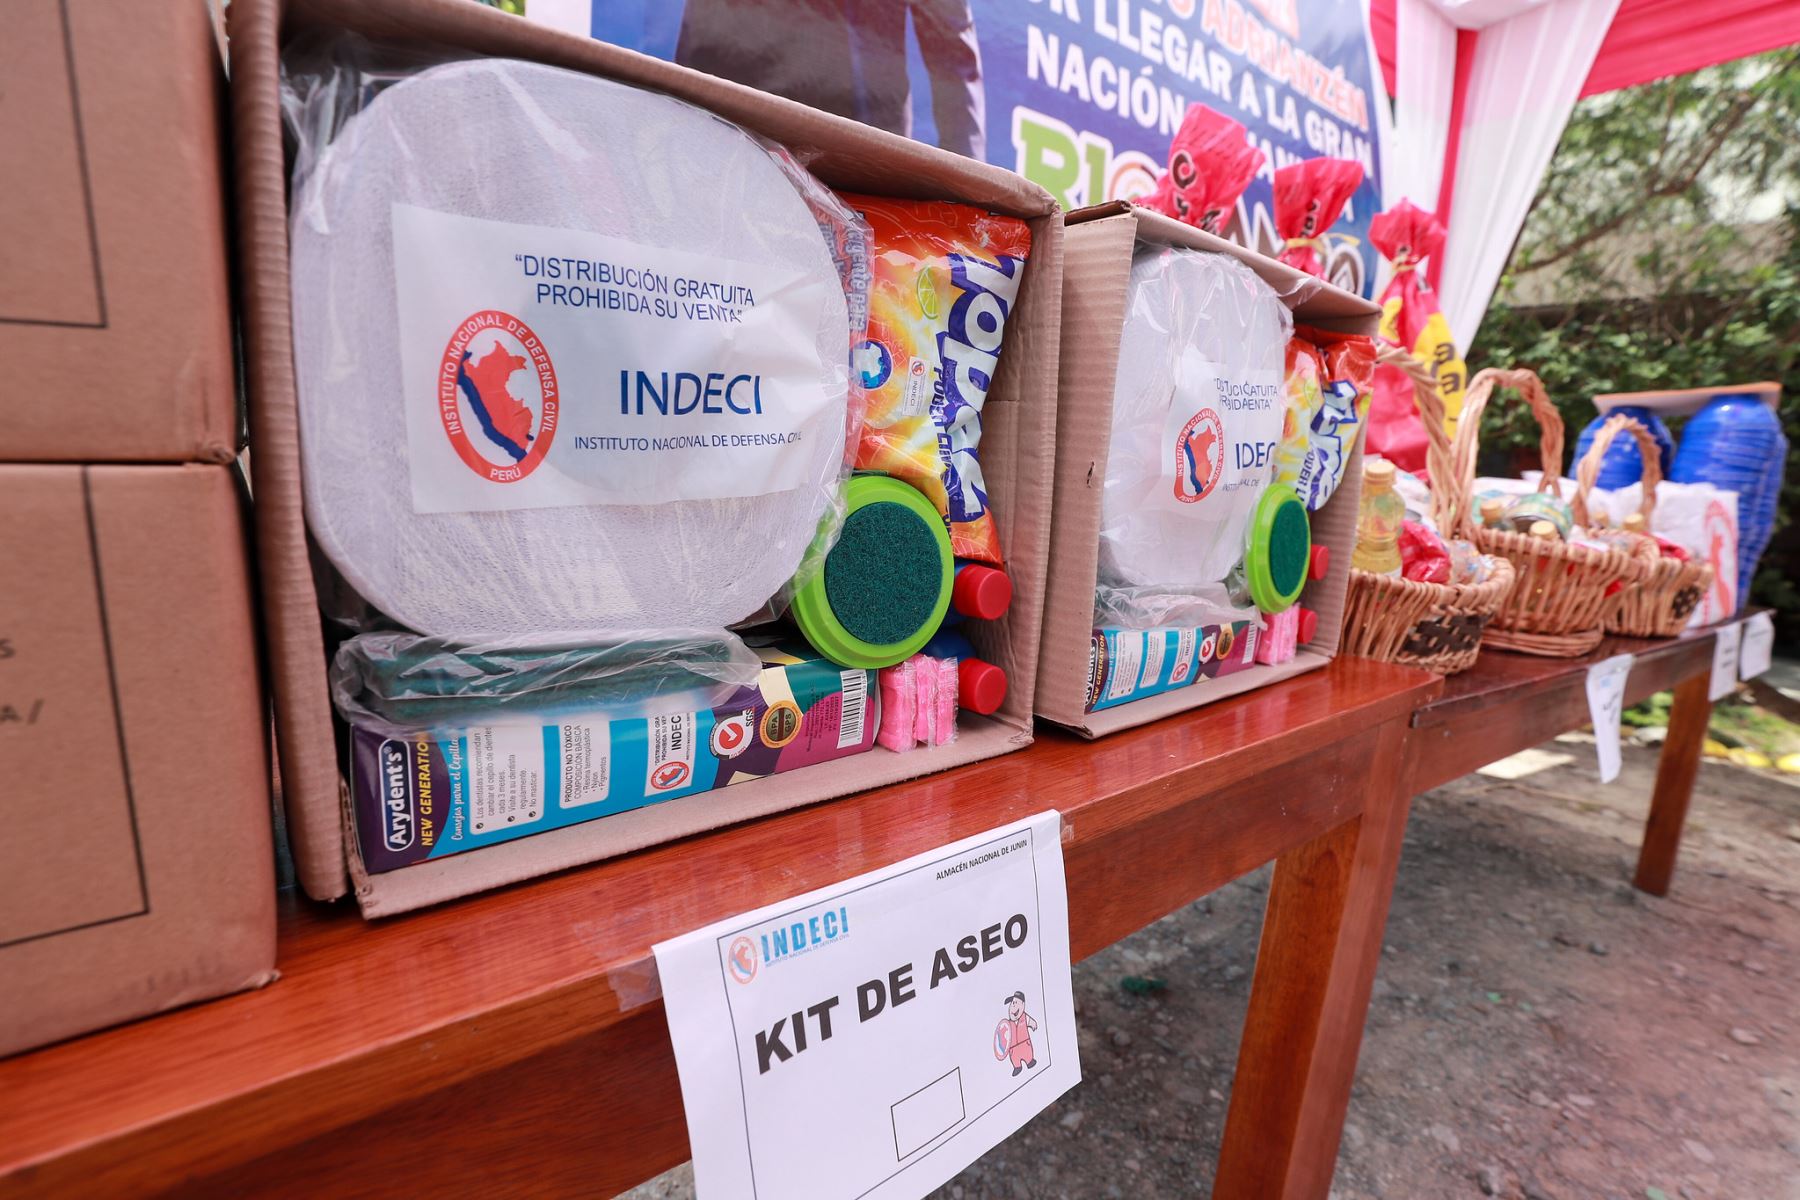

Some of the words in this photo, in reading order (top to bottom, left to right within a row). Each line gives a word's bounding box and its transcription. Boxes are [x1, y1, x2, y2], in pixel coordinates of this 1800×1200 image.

[1027, 24, 1186, 135] NACIÓN
[1094, 0, 1233, 102] LLEGAR
[1239, 71, 1262, 117] A
[1266, 84, 1301, 138] LA
[1304, 110, 1374, 179] GRAN
[537, 283, 651, 316] PROHIBIDA
[654, 299, 678, 319] SU
[673, 278, 755, 307] GRATUITA
[448, 314, 503, 359] NACIONAL
[506, 320, 527, 338] DE
[525, 339, 555, 398] DEFENSA
[441, 362, 462, 436] INSTITUTO
[620, 370, 763, 416] INDECI
[541, 402, 556, 433] CIVIL
[574, 436, 649, 451] INSTITUTO
[652, 435, 709, 451] NACIONAL
[712, 434, 728, 447] DE
[730, 433, 786, 447] DEFENSA
[490, 466, 521, 481] PERÚ
[1095, 634, 1105, 685] GENERATION
[1092, 687, 1100, 704] NEW
[745, 709, 754, 727] SGS
[770, 716, 778, 735] BPA
[785, 713, 793, 732] GPS
[564, 725, 573, 752] TÓXICO
[574, 725, 582, 751] BÁSICA
[671, 715, 682, 751] INDEC
[474, 733, 484, 776] recomiendan
[485, 752, 494, 761] de
[565, 754, 573, 764] NO
[584, 728, 592, 769] termoplástica
[417, 734, 432, 814] GENERATIO
[450, 772, 461, 780] el
[485, 763, 496, 783] cepillo
[506, 754, 516, 779] dentista
[574, 753, 582, 799] COMPOSICIÓN
[591, 772, 599, 788] Nylon
[599, 756, 607, 786] Pigmentos
[452, 783, 466, 804] para
[475, 778, 484, 805] dentistas
[508, 780, 516, 788] su
[565, 766, 573, 802] PRODUCTO
[388, 753, 411, 844] Arydent's
[485, 792, 495, 816] cambiar
[498, 799, 506, 814] cada
[507, 796, 516, 811] Visite
[529, 798, 537, 807] No
[451, 807, 465, 840] Consejos
[475, 807, 484, 818] Los
[420, 818, 433, 846] NEW
[936, 861, 968, 880] ALMACÉN
[969, 850, 1000, 868] NACIONAL
[1001, 846, 1009, 856] DE
[761, 906, 849, 963] INDECI
[755, 996, 839, 1076] KIT
[856, 963, 917, 1023] DE
[929, 913, 1029, 990] ASEO
